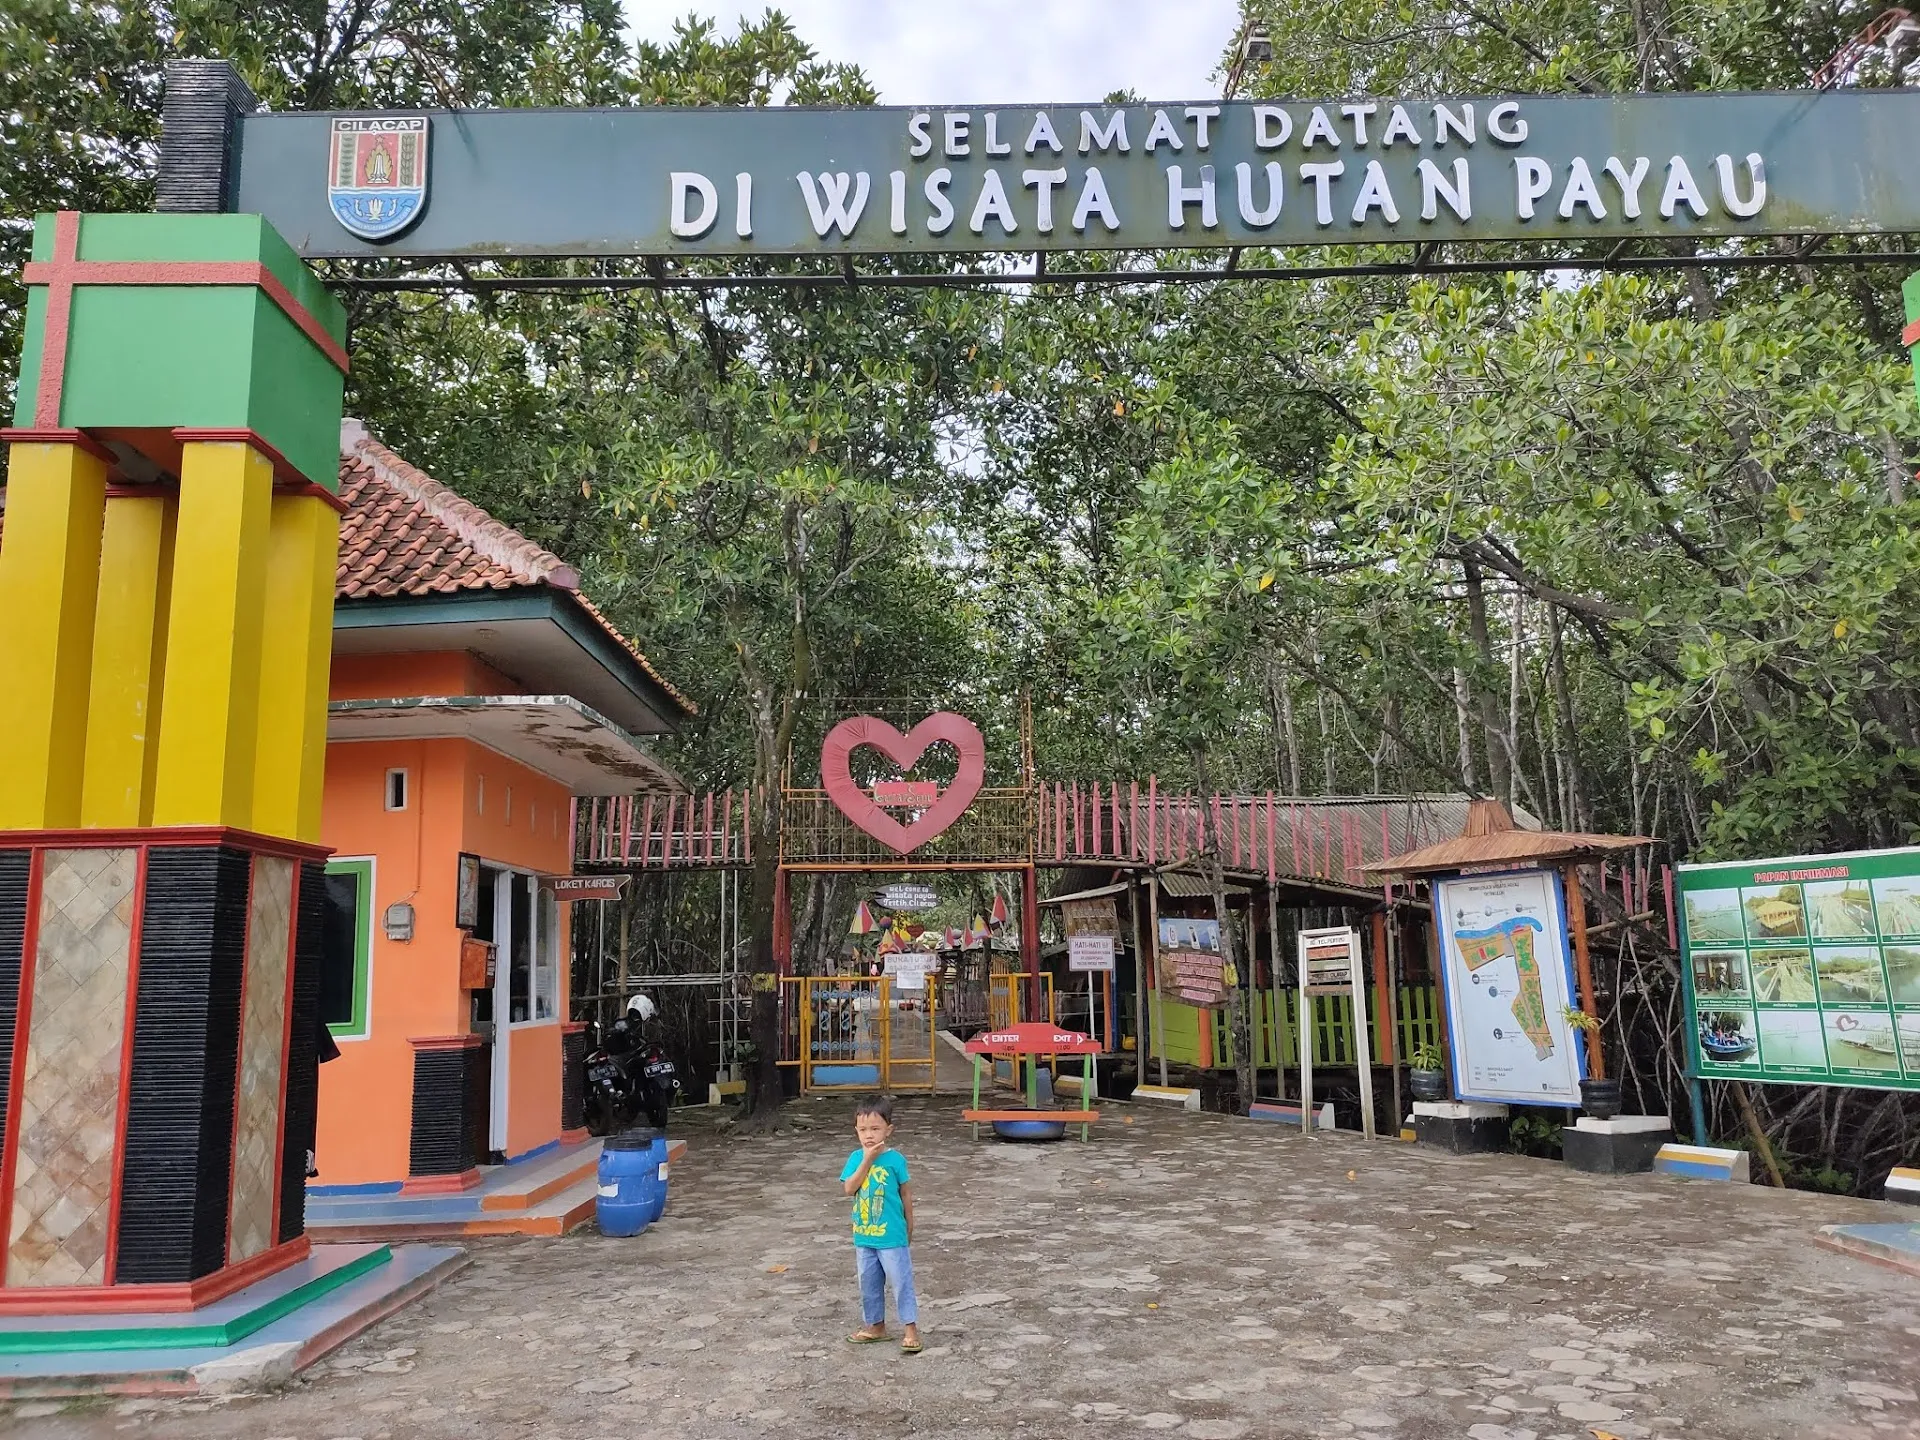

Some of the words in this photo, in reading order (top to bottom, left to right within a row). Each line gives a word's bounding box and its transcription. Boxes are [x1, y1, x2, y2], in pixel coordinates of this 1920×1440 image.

[337, 120, 422, 131] CILACAP
[908, 105, 1221, 158] SELAMAT
[1252, 100, 1530, 151] DATANG
[669, 171, 753, 240] DI
[796, 165, 1121, 238] WISATA
[1166, 154, 1473, 232] HUTAN
[1515, 151, 1769, 222] PAYAU
[1754, 872, 1789, 883] PAPAN
[1790, 866, 1850, 882] INFORMASI
[554, 880, 583, 890] LOKET
[584, 878, 616, 888] KARCIS
[991, 1034, 1019, 1043] ENTER
[1053, 1034, 1072, 1043] EXIT
